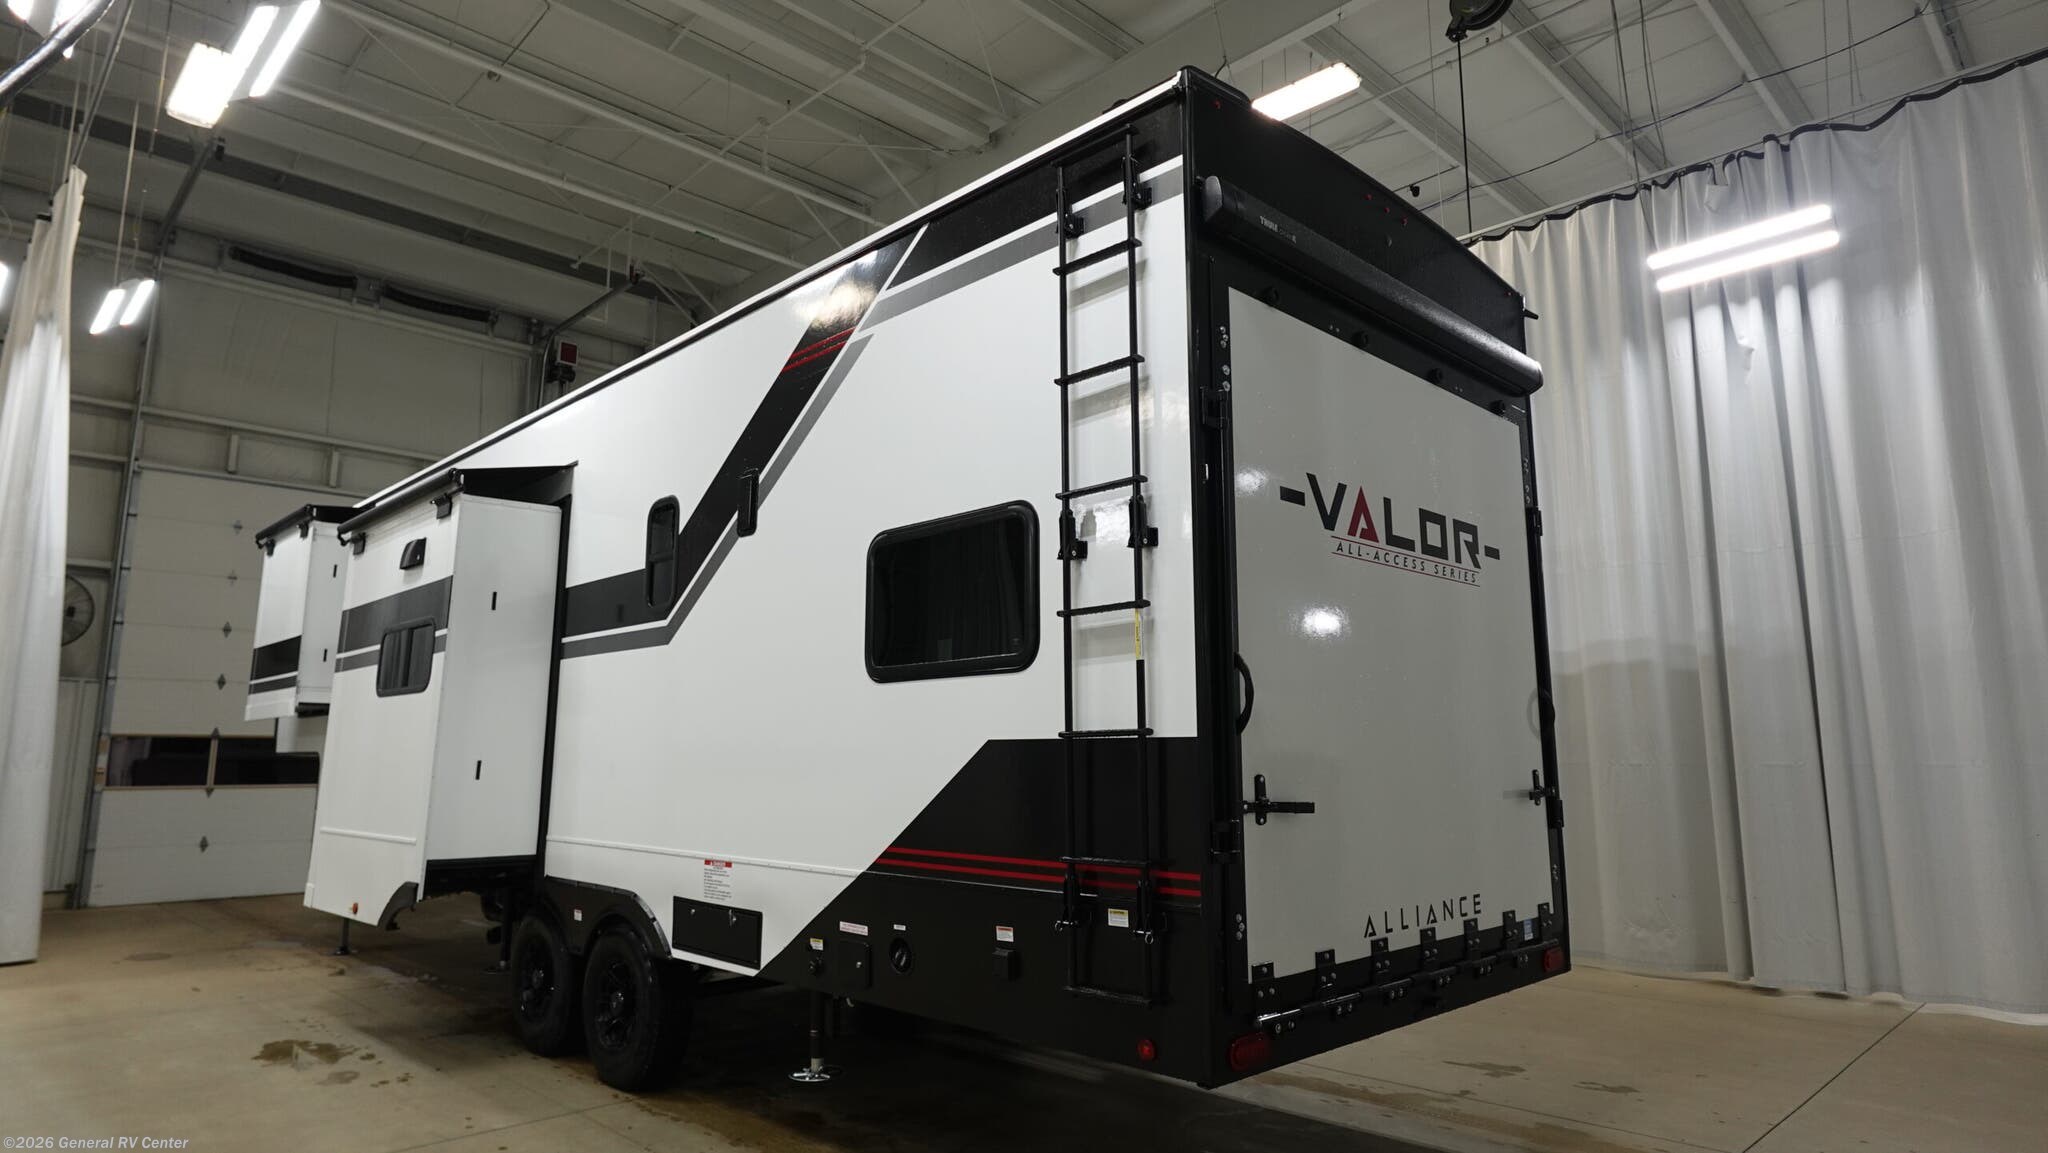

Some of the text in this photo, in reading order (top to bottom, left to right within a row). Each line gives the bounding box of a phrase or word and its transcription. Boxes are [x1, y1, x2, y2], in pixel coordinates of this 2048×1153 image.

[1336, 541, 1478, 583] ALL-ACCESS SERIES
[1363, 893, 1482, 939] ALLIANCE
